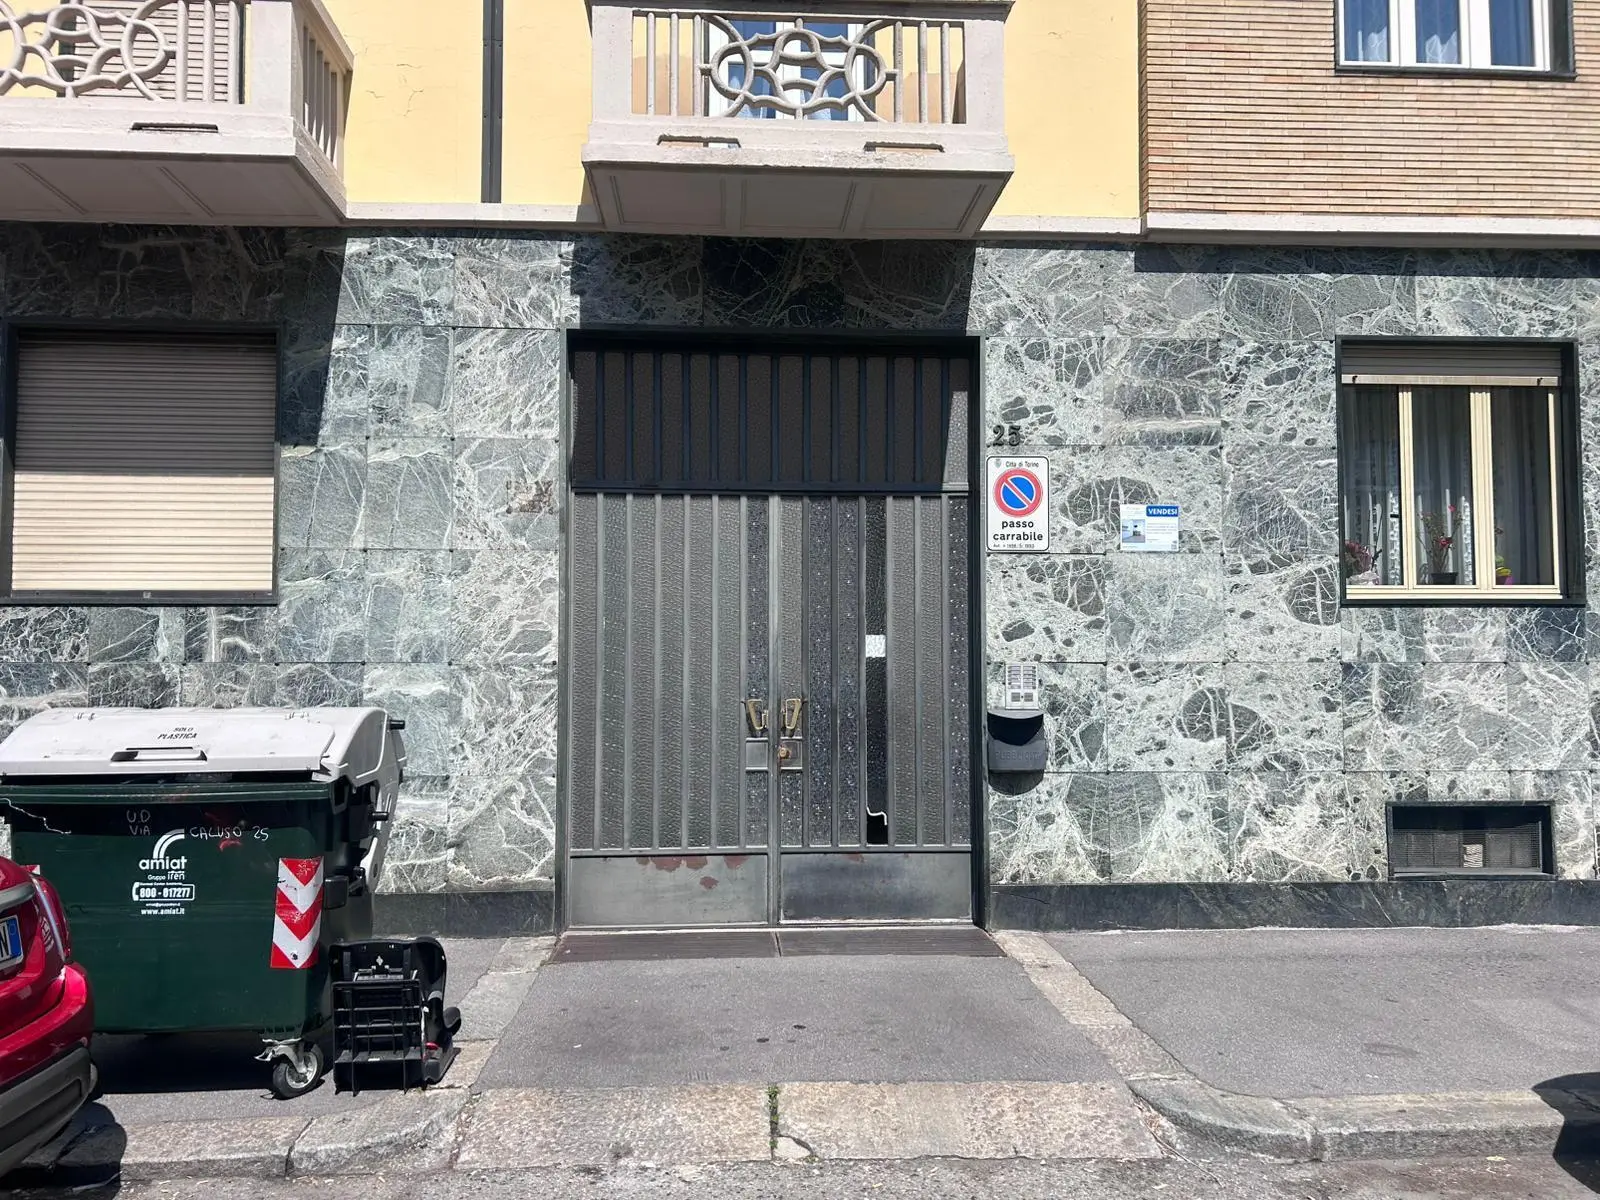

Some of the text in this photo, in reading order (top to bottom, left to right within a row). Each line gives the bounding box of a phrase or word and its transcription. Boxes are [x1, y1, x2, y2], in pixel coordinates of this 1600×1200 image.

[993, 425, 1021, 446] 25
[1002, 521, 1034, 529] passo
[993, 532, 1043, 540] carrabile
[190, 826, 242, 840] CALUSO
[252, 826, 268, 841] 25
[138, 856, 188, 870] amiat
[140, 888, 156, 898] 800
